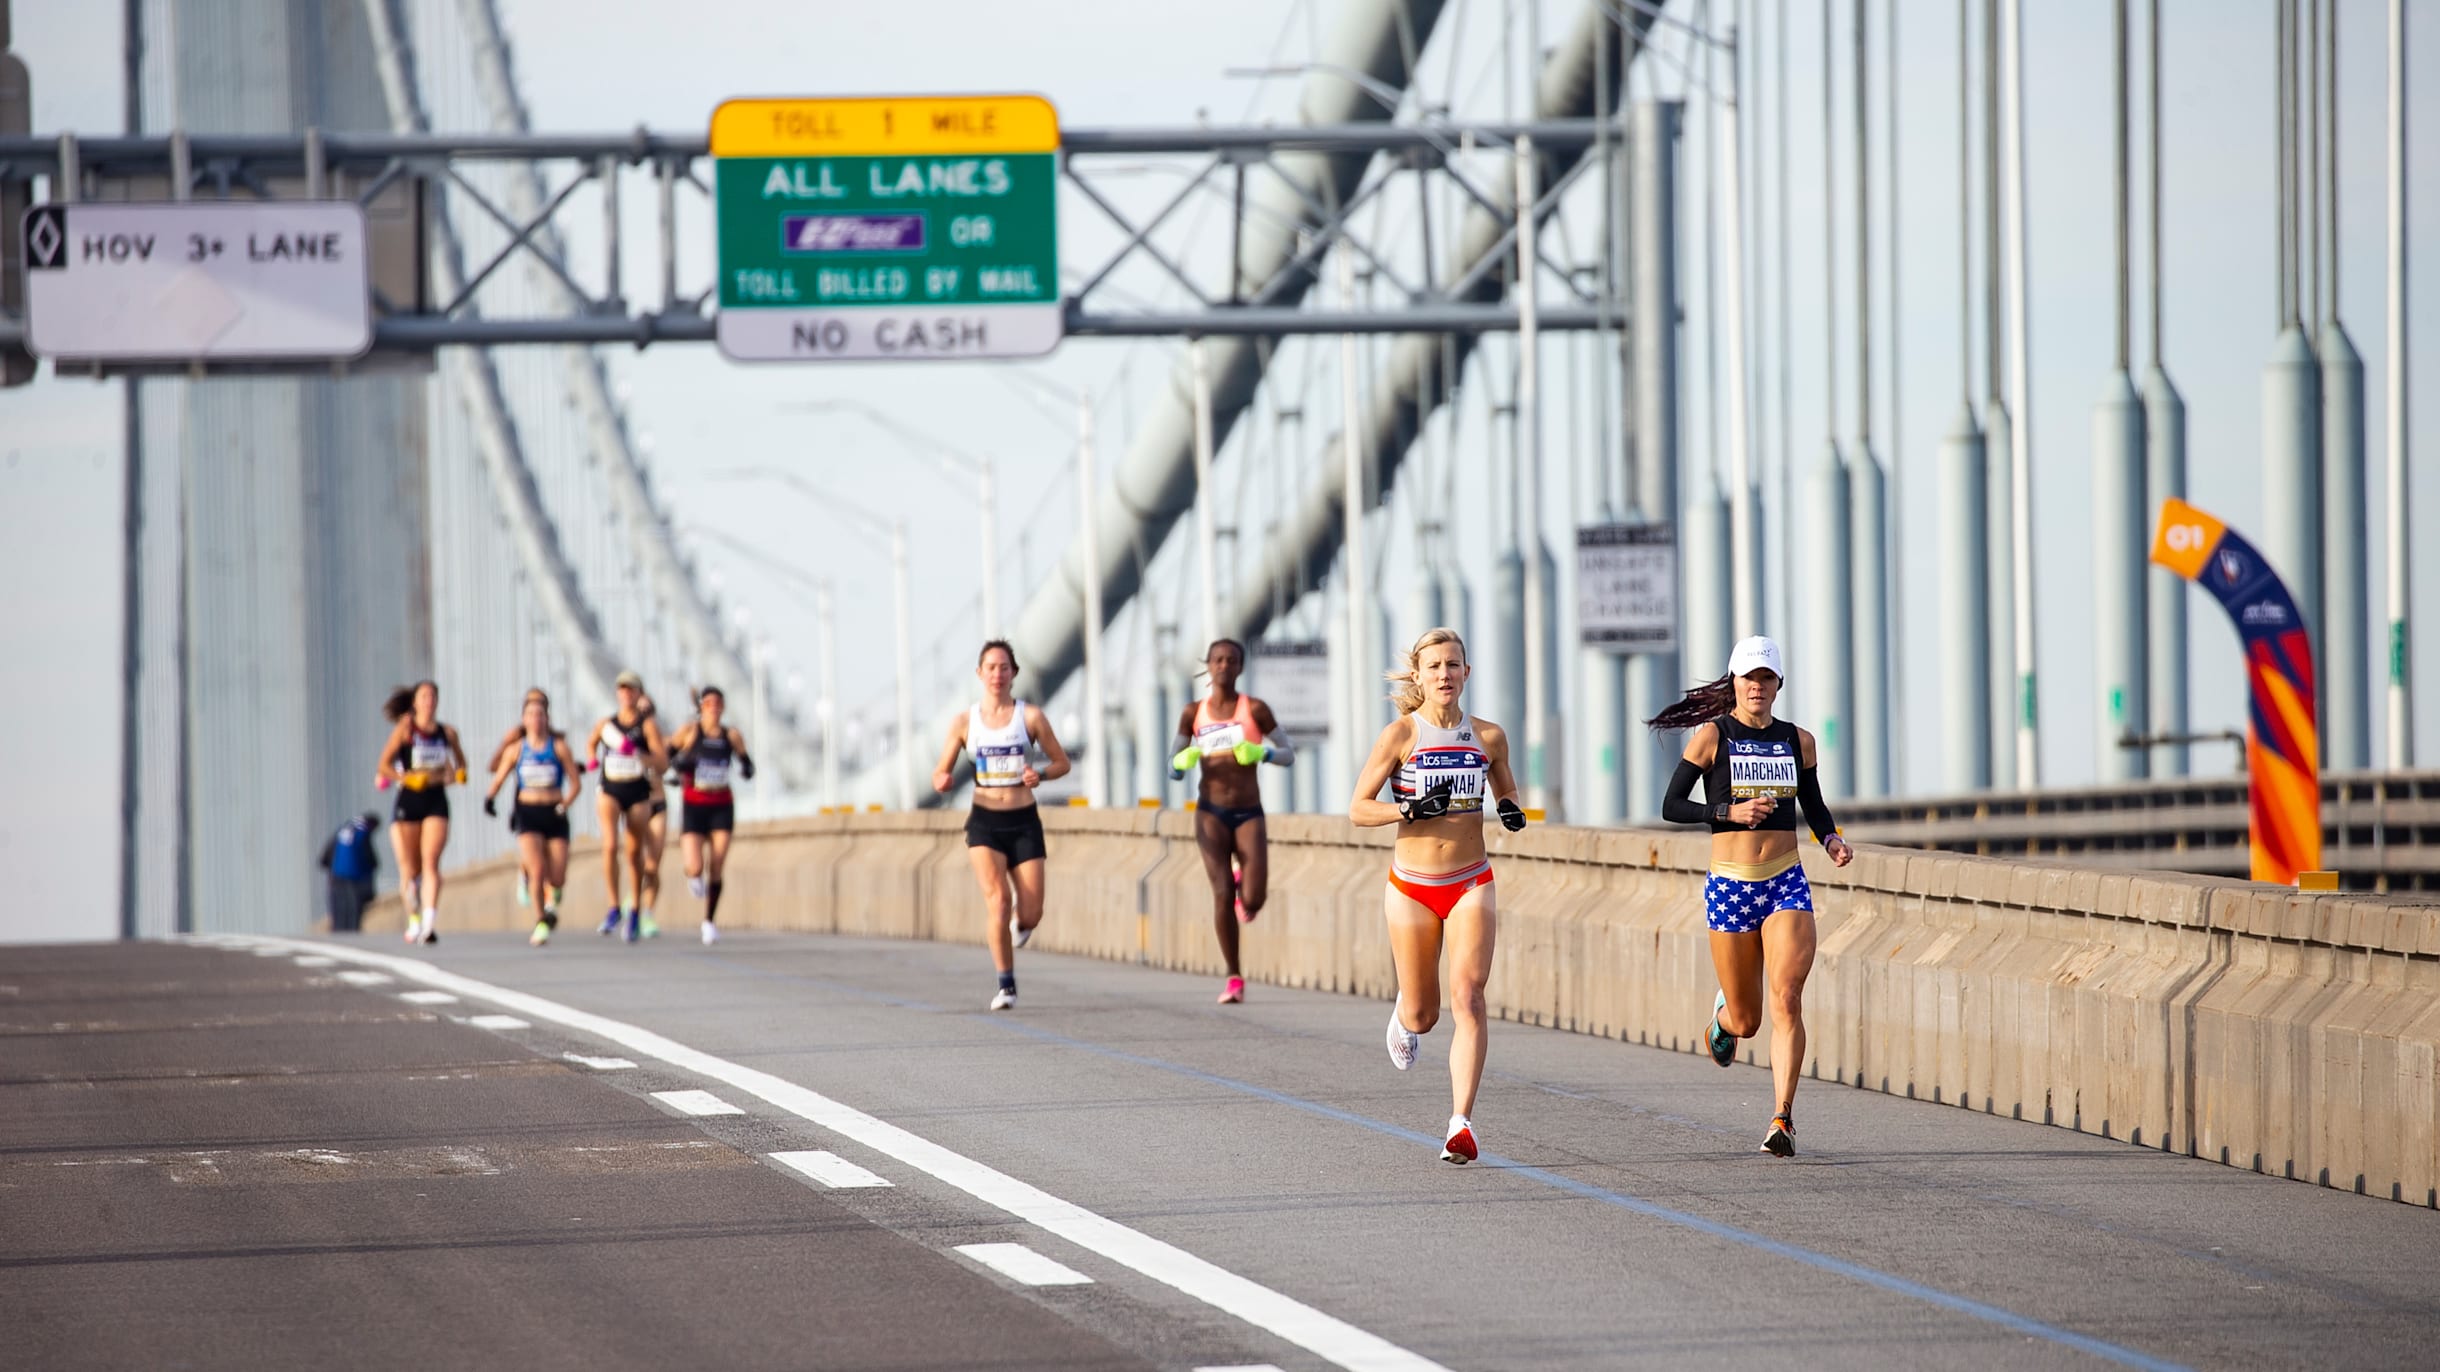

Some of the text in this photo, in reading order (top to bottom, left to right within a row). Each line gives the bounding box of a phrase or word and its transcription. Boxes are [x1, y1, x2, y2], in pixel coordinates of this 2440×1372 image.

[769, 110, 841, 139] TOLL
[930, 108, 998, 136] MILE
[763, 160, 1012, 197] ALL LANES
[951, 217, 994, 246] OR
[82, 232, 341, 263] HOV 3+ LANE
[735, 267, 1039, 297] TOLL BILLED BY MAIL
[792, 317, 988, 351] NO CASH
[1423, 754, 1440, 766] tcs
[1736, 742, 1753, 753] tcs
[1733, 762, 1794, 780] MARCHANT
